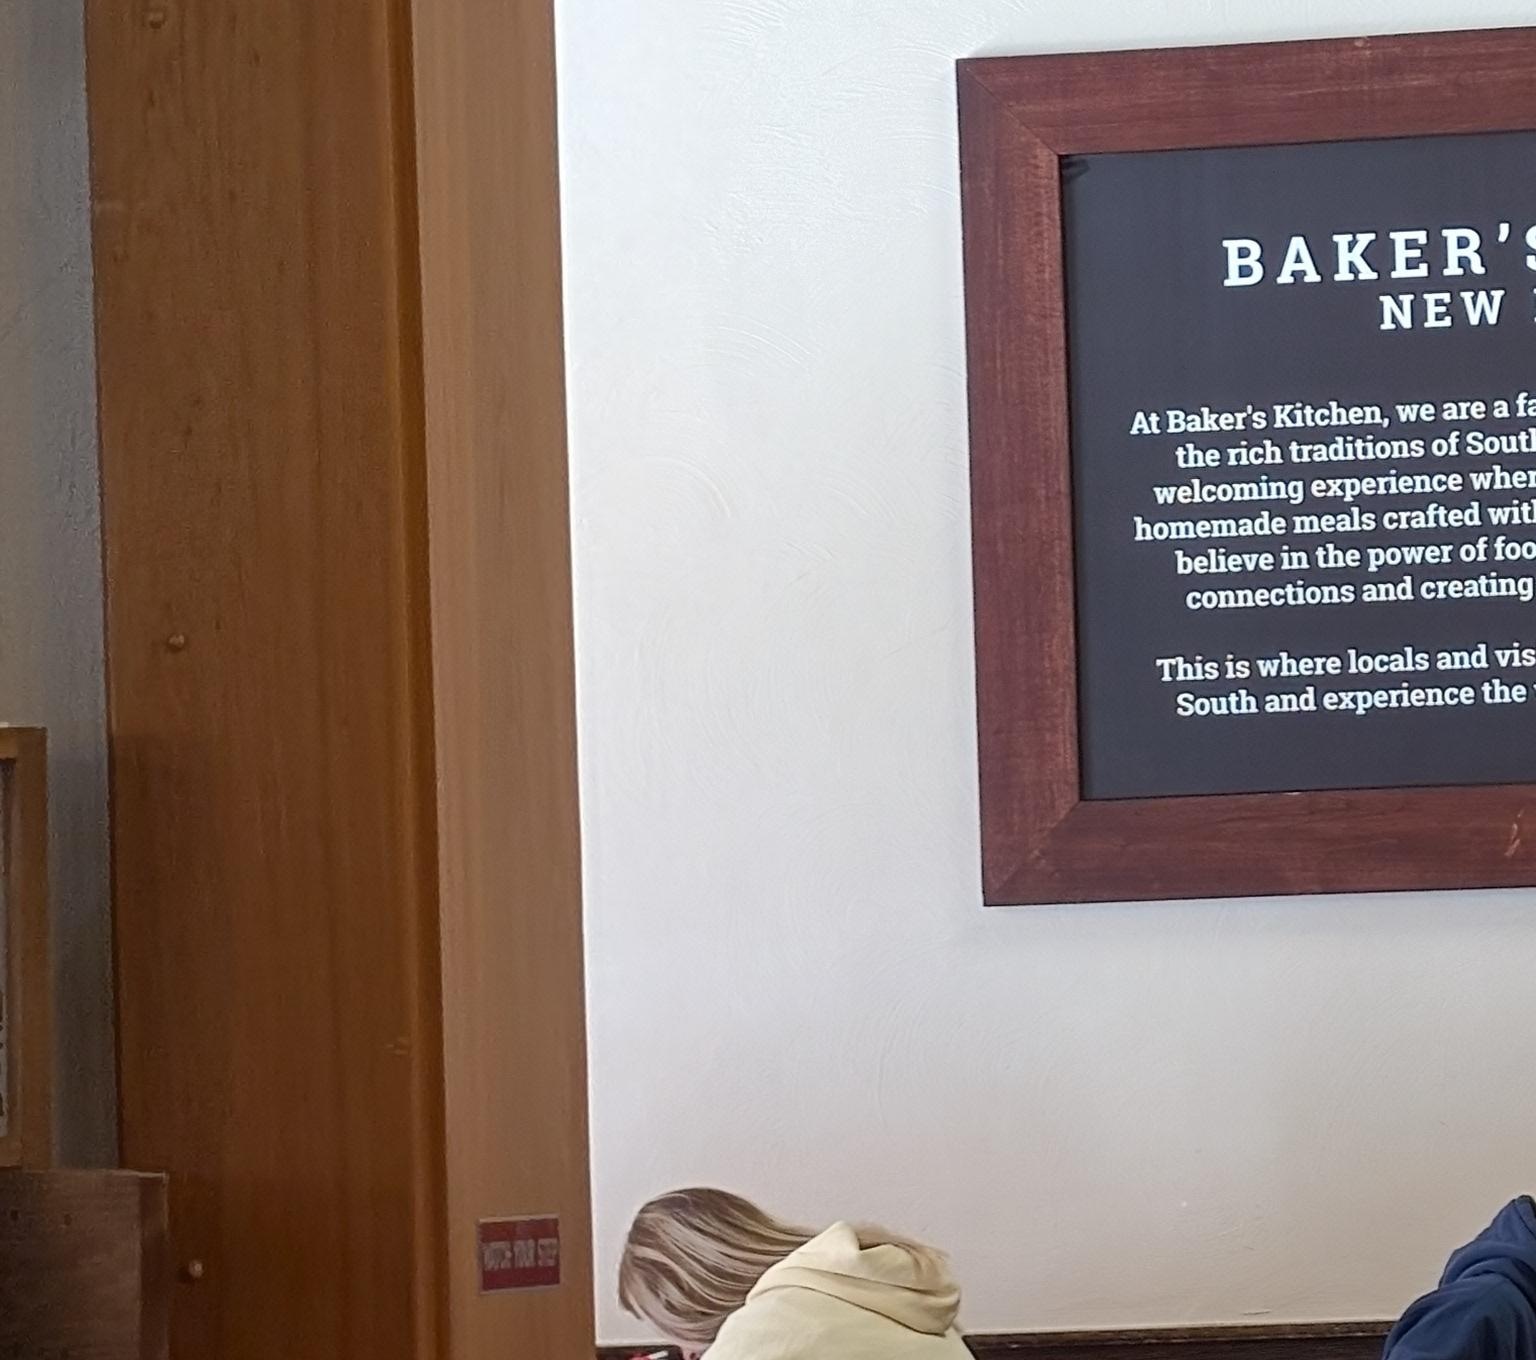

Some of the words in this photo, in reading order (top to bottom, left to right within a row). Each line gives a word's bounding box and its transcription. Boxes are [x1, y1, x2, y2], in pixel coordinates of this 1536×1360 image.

[1379, 290, 1505, 330] NEW
[1130, 412, 1161, 434] At
[1166, 405, 1267, 433] Baker's
[1273, 401, 1389, 428] Kitchen,
[1395, 404, 1435, 422] we
[1442, 401, 1486, 420] are
[1493, 400, 1510, 418] a
[1175, 443, 1220, 468] the
[1227, 440, 1283, 465] rich
[1289, 435, 1424, 462] traditions
[1432, 431, 1460, 456] of
[1153, 476, 1303, 504] welcoming
[1311, 470, 1462, 502] experience
[1134, 511, 1286, 541] homemade
[1292, 507, 1376, 533] meals
[1383, 502, 1482, 529] crafted
[1175, 548, 1274, 574] believe
[1280, 546, 1310, 569] in
[1315, 544, 1360, 568] the
[1367, 545, 1453, 572] power
[1460, 537, 1488, 562] of
[1186, 580, 1355, 609] connections
[1362, 576, 1414, 601] and
[1421, 572, 1533, 601] creating
[1156, 656, 1219, 681] This
[1225, 655, 1250, 678] is
[1256, 652, 1341, 677] where
[1348, 647, 1429, 673] locals
[1437, 644, 1488, 670] and
[1177, 690, 1258, 716] South
[1265, 687, 1317, 712] and
[1323, 683, 1474, 715] experience
[1481, 679, 1526, 703] the
